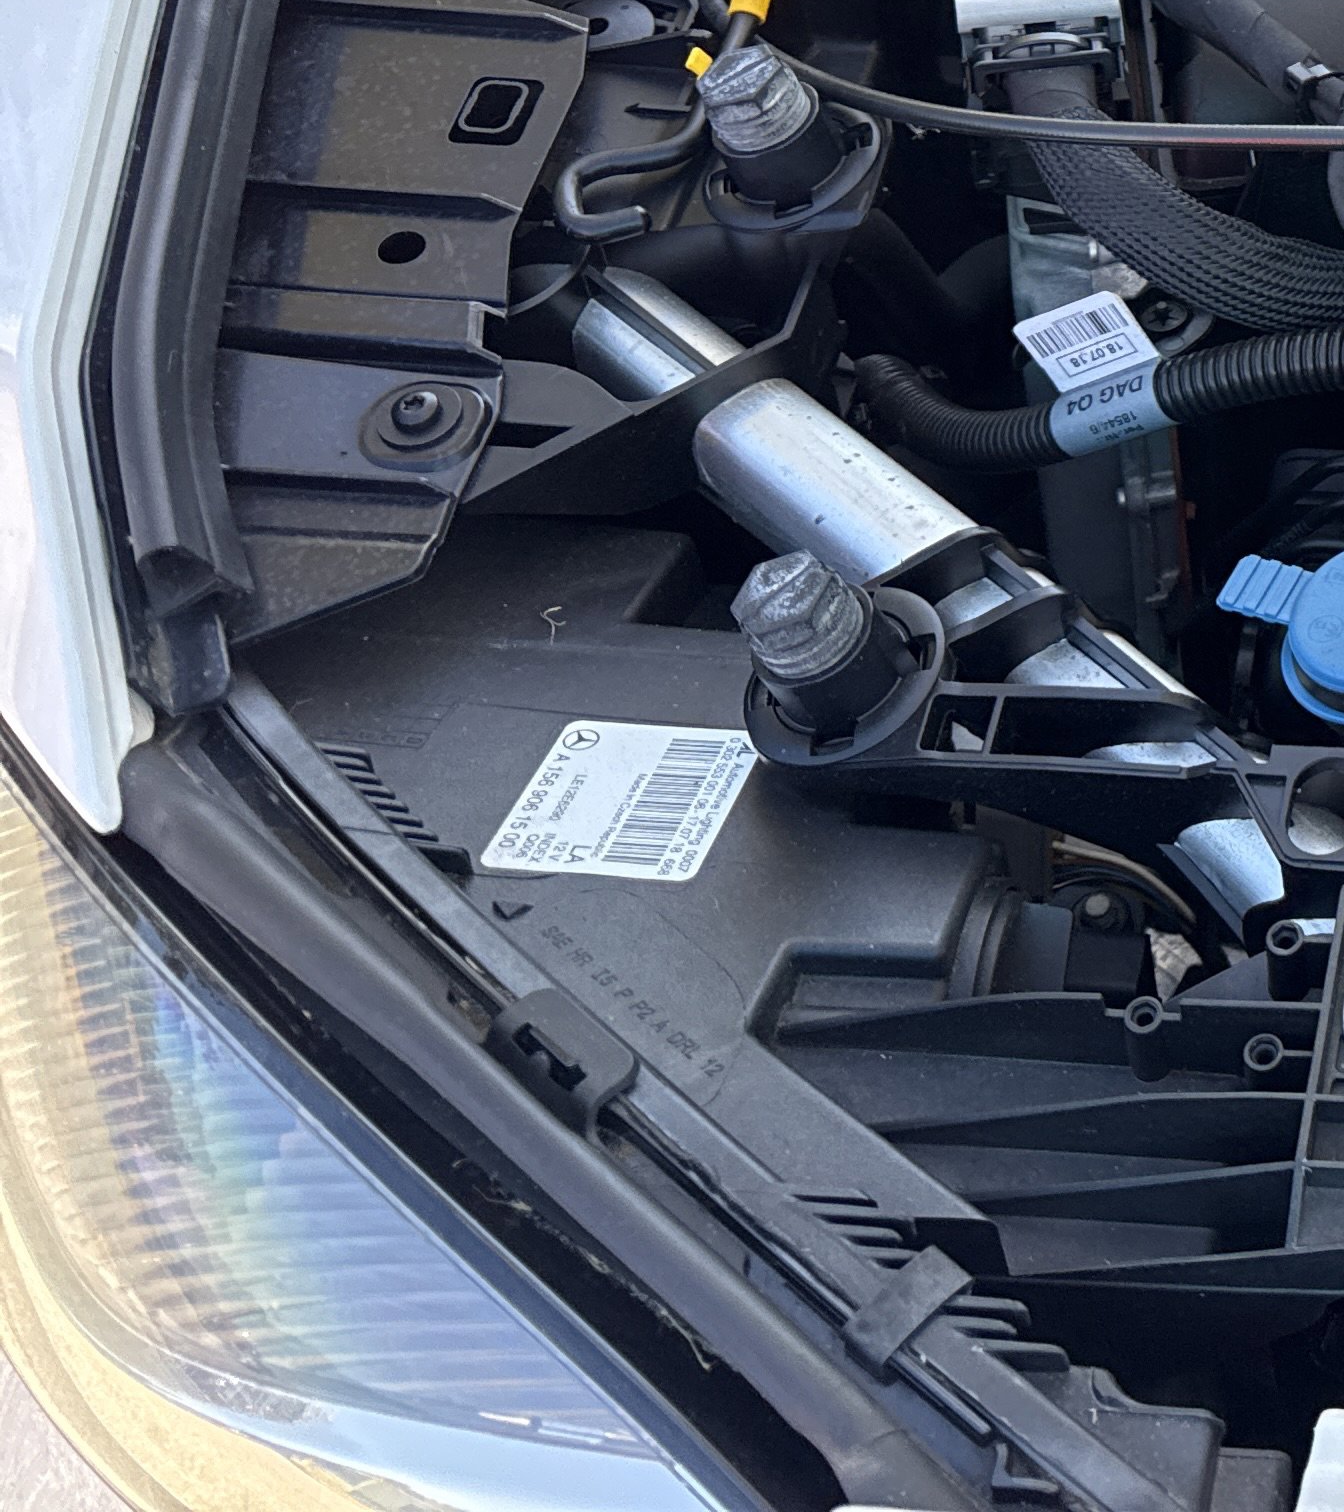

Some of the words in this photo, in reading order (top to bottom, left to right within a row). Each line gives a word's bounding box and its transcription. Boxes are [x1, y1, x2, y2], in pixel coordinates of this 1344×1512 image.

[1099, 375, 1144, 403] DAG
[552, 753, 571, 762] A
[721, 745, 737, 761] 302
[537, 766, 563, 786] 156
[711, 763, 728, 778] 553
[702, 781, 718, 795] 001
[710, 762, 744, 809] Automotive
[521, 790, 548, 811] 906
[510, 816, 531, 830] 15
[688, 812, 720, 845] Lighting
[498, 833, 520, 848] 00
[528, 833, 556, 863] INDEX
[563, 845, 592, 863] LA
[541, 925, 574, 950] SAE
[566, 947, 594, 967] HR
[614, 987, 634, 998] P
[628, 1000, 656, 1021] P2
[650, 1019, 670, 1033] A
[666, 1030, 701, 1060] DRL
[700, 1058, 725, 1078] 12
